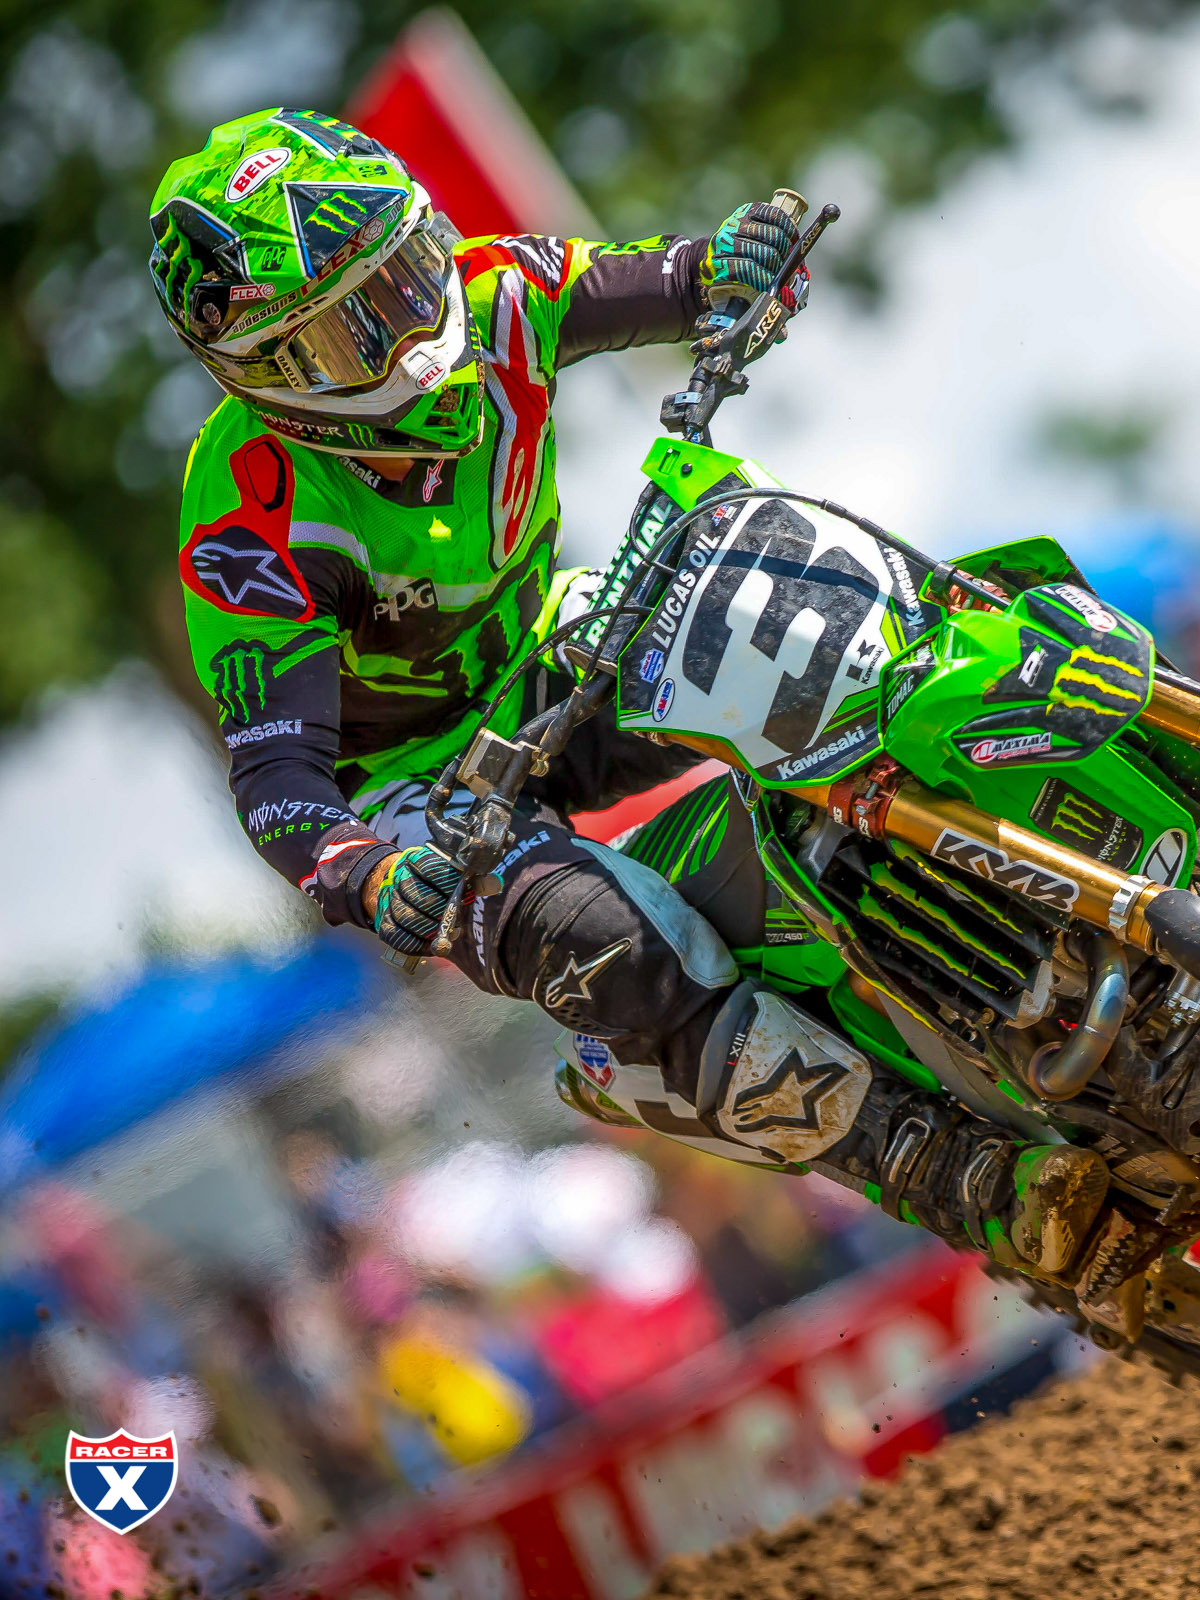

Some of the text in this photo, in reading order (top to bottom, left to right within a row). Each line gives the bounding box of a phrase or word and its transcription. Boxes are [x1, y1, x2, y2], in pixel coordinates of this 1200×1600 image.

[233, 154, 282, 193] BELL
[231, 284, 264, 300] FLEX
[277, 355, 302, 389] OAKLEY
[418, 365, 444, 388] BELL
[373, 582, 435, 621] PPG
[653, 532, 720, 649] LUCAS OIL
[883, 547, 925, 627] Kawasaki
[682, 498, 879, 756] 3
[860, 646, 885, 685] Kawasaki
[886, 674, 915, 720] TOMAC
[776, 725, 867, 780] Kawasaki
[258, 822, 330, 847] ENERGY
[930, 827, 1080, 913] KYB
